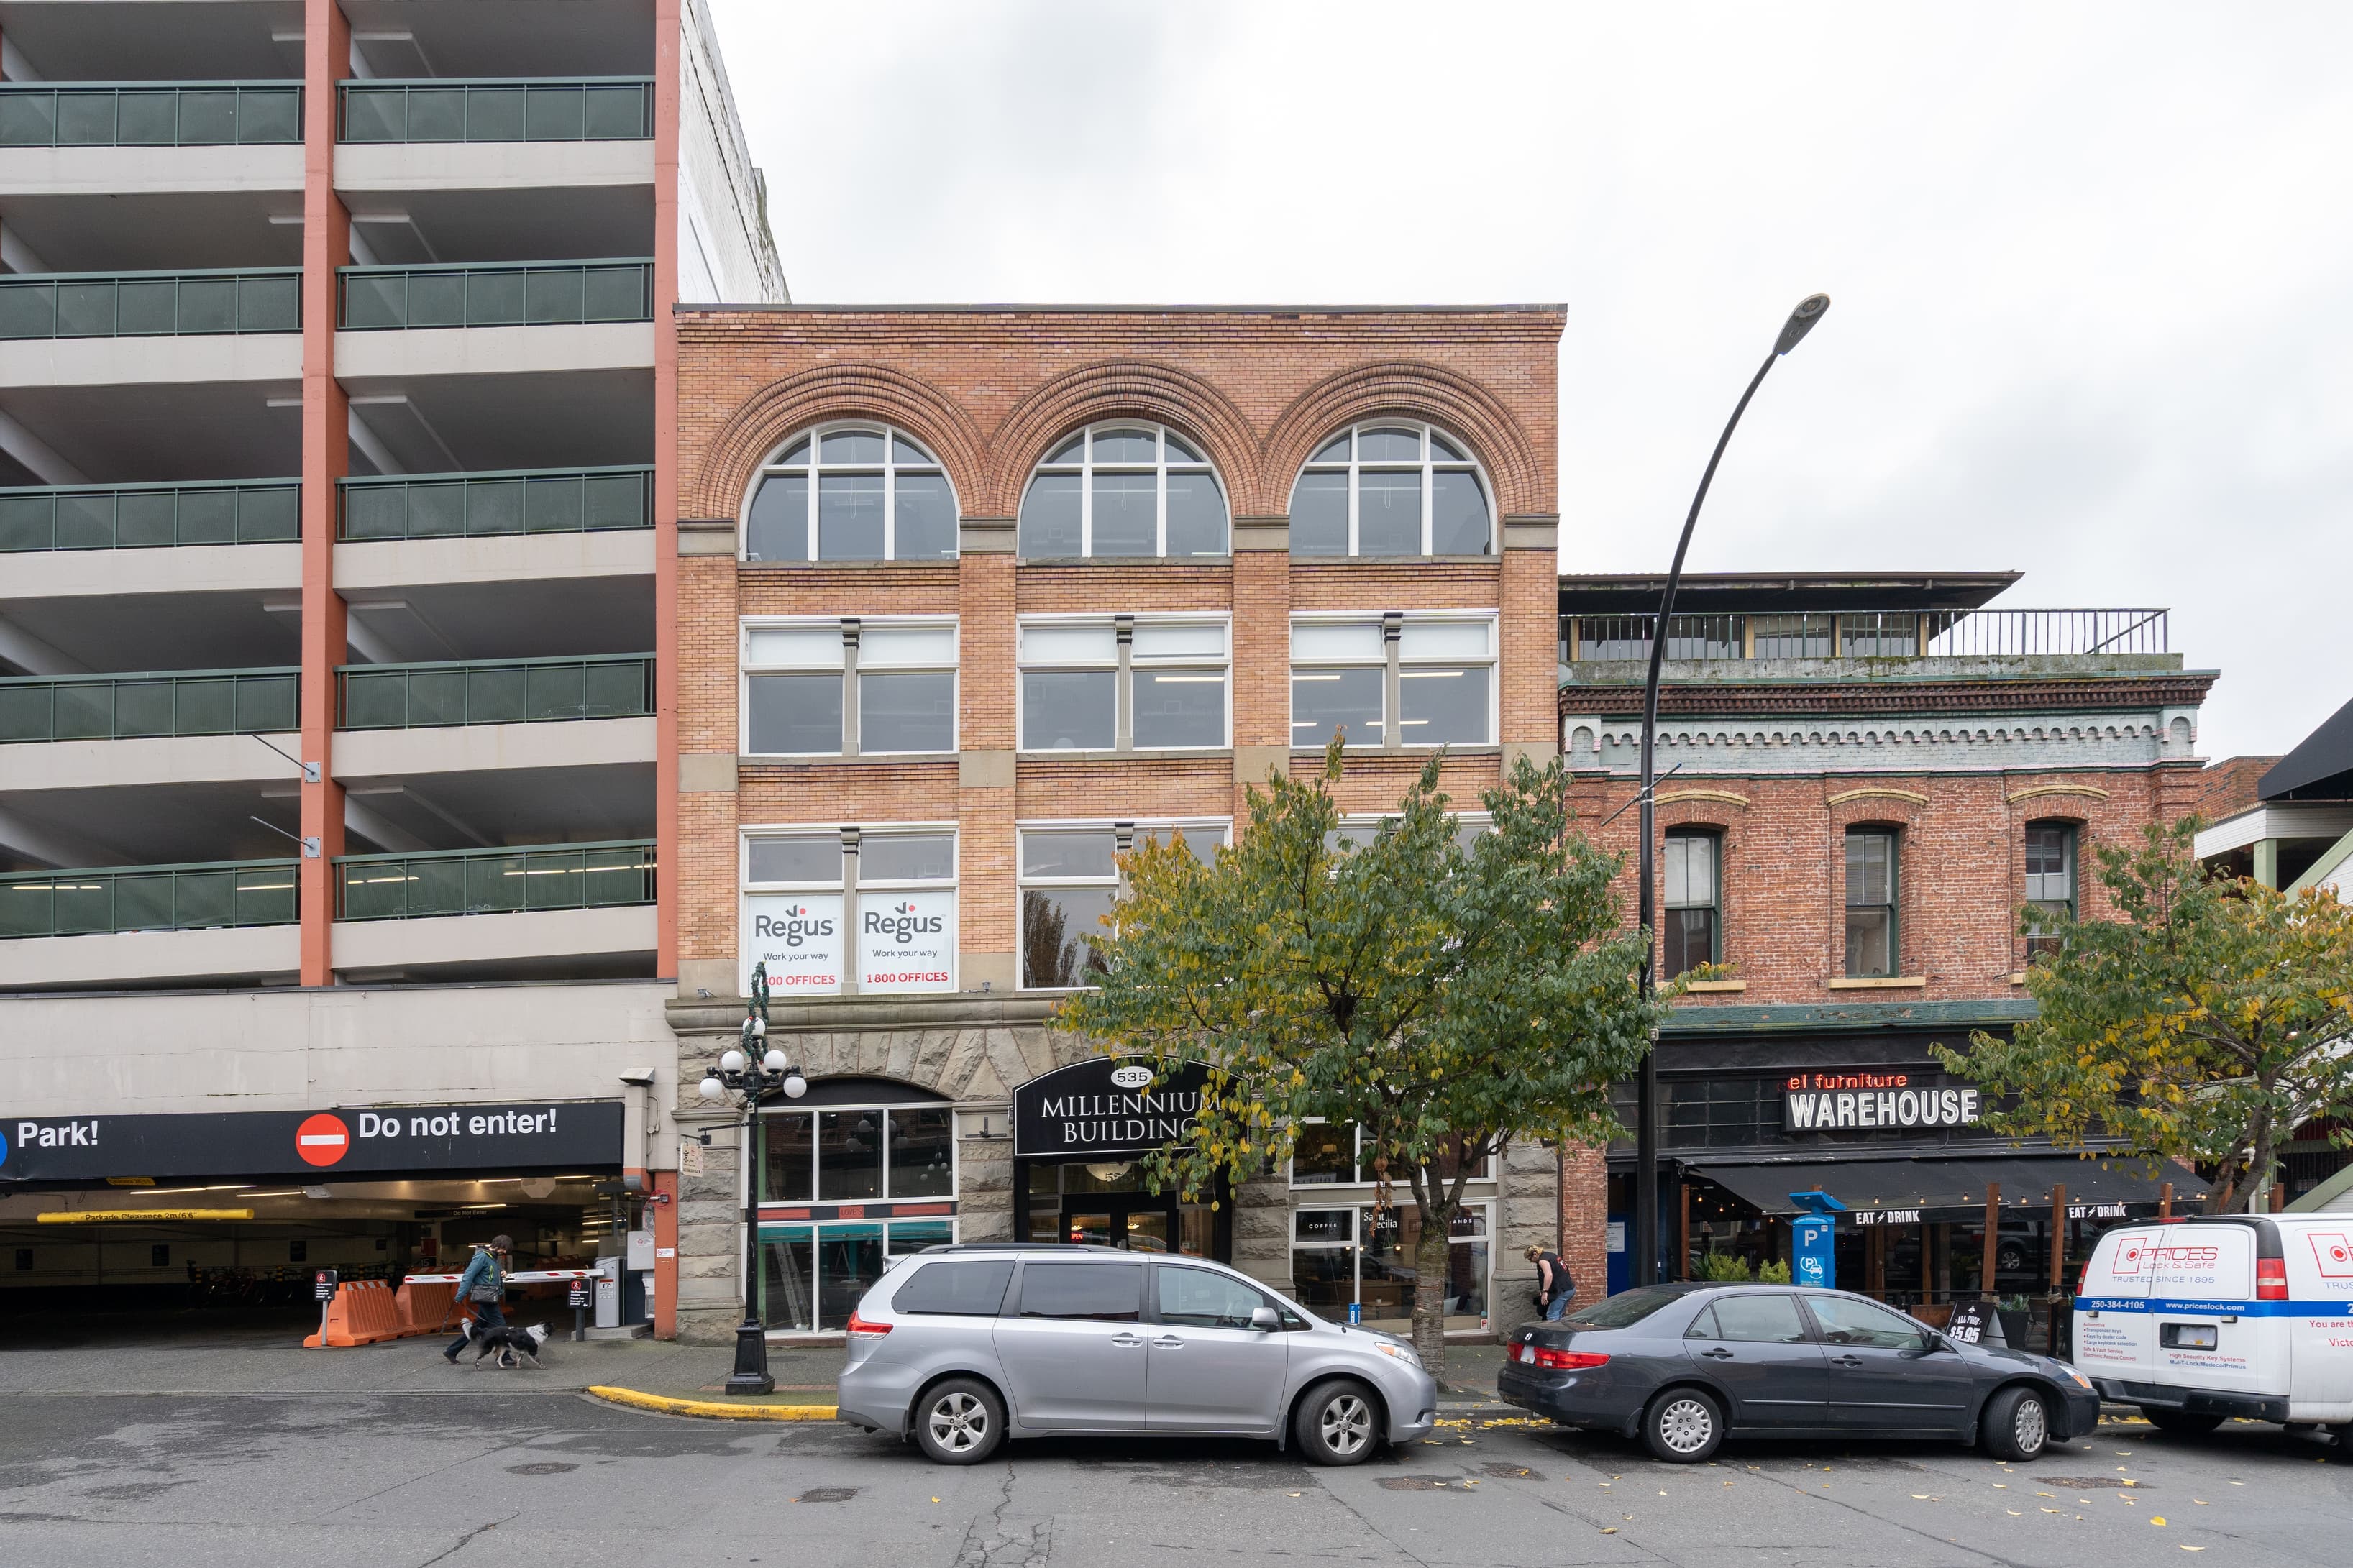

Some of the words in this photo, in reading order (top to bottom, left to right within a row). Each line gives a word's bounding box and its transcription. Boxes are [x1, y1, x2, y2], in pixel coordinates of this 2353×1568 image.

[755, 915, 833, 947] Regus
[864, 912, 943, 943] Regus
[788, 953, 809, 962] your
[764, 976, 783, 986] 00
[785, 975, 836, 985] OFFICES
[898, 972, 949, 982] OFFICES
[1117, 1072, 1148, 1082] 535
[1788, 1074, 1807, 1089] el
[1815, 1073, 1908, 1089] furniture
[1041, 1091, 1223, 1117] MILLENNIUM
[1789, 1089, 1978, 1128] WAREHOUSE
[359, 1112, 401, 1138] Do
[411, 1111, 460, 1137] not
[469, 1108, 557, 1134] enter!
[18, 1120, 99, 1147] Park!
[1856, 1212, 1875, 1224] EAT
[1887, 1210, 1920, 1224] DRINK
[2069, 1206, 2086, 1218] EAT
[2097, 1205, 2126, 1217] DRINK
[1370, 1219, 1397, 1230] ecilia
[1804, 1229, 1818, 1247] P
[2140, 1247, 2219, 1260] PRICES
[2142, 1260, 2170, 1269] Lock
[2172, 1260, 2182, 1269] &
[2184, 1260, 2216, 1269] Safe
[2091, 1300, 2145, 1309] 250-384-4105
[2165, 1302, 2245, 1311] www.priceslock.com
[1957, 1315, 1967, 1324] ALL
[1949, 1326, 1981, 1343] $5.95
